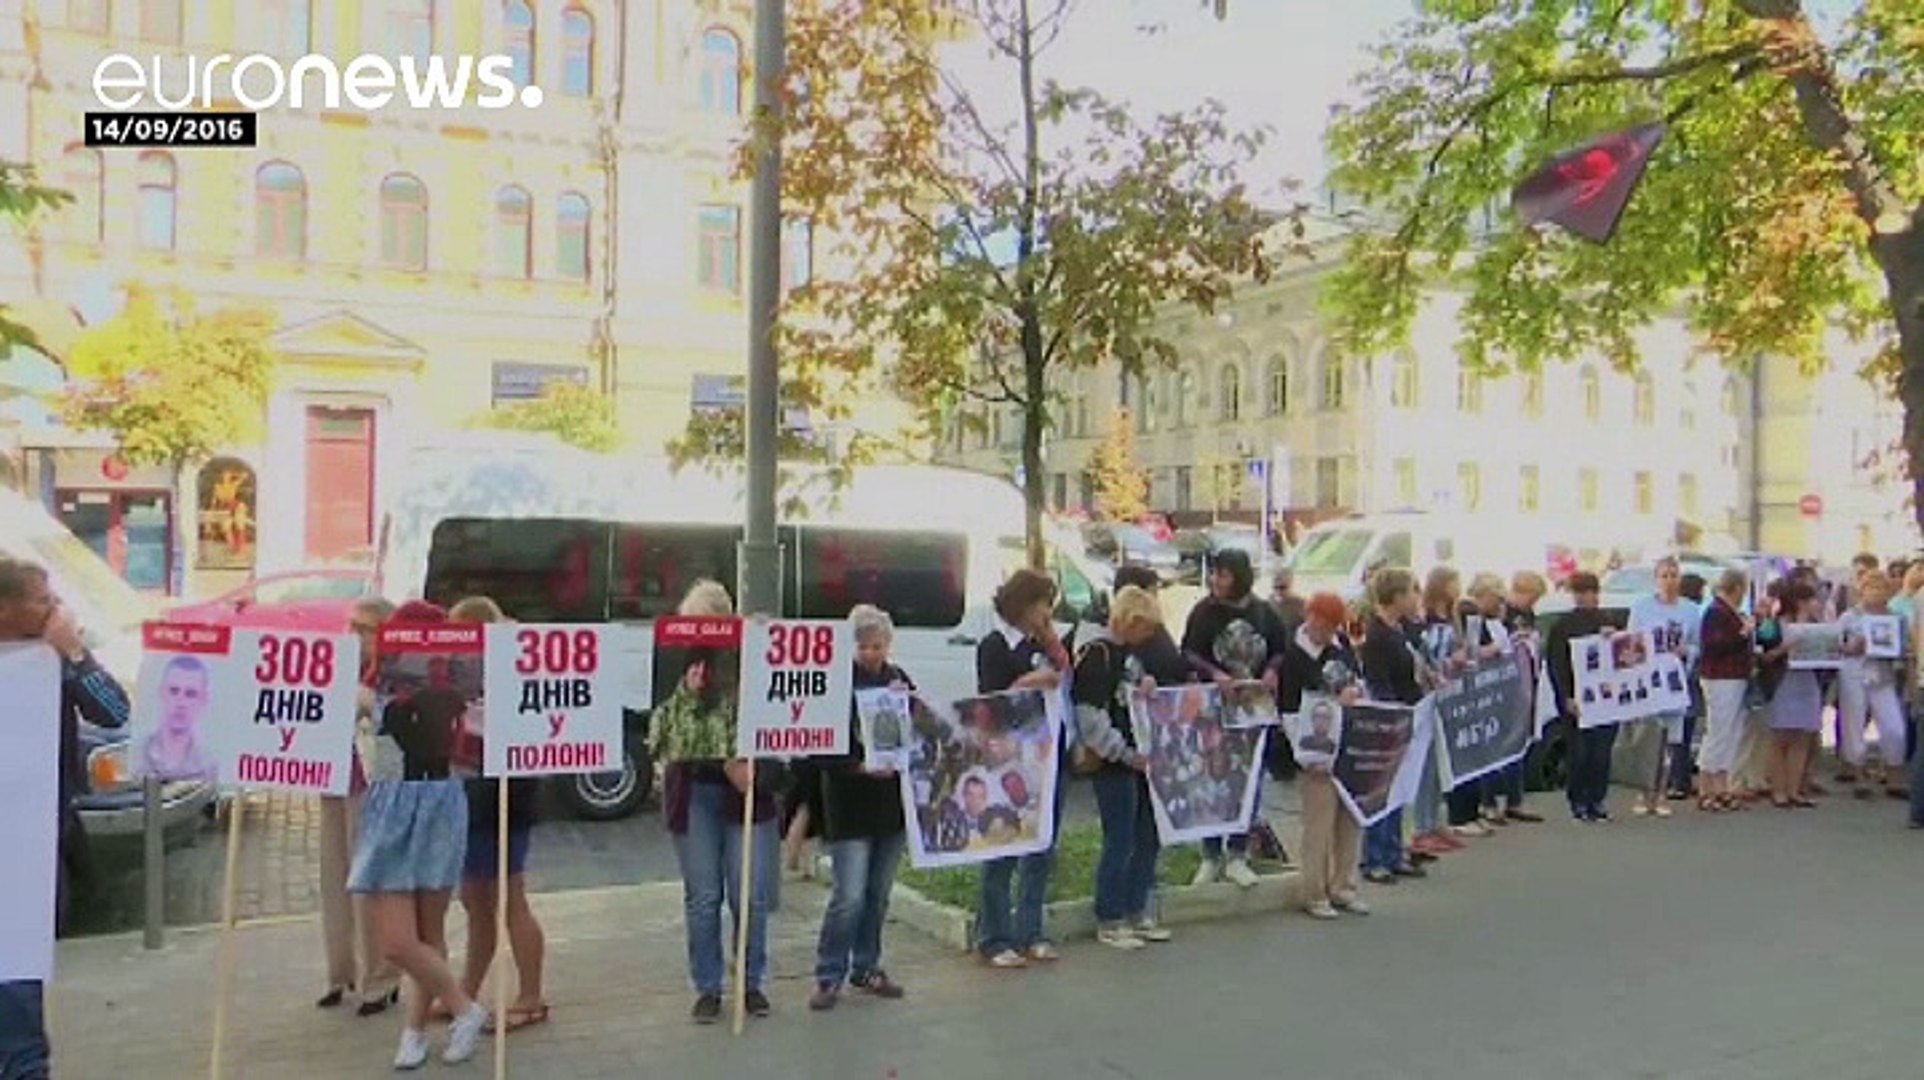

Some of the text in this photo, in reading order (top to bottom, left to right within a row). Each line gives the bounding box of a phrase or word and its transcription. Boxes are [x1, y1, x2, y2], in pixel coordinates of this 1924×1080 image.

[255, 634, 334, 688] 308
[516, 629, 598, 675] 308
[766, 624, 834, 667] 308
[517, 679, 592, 714] ДНІВ
[767, 670, 828, 703] ДНІВ
[254, 688, 325, 725] ДНІВ
[507, 743, 605, 770] ПОЛОНІ!
